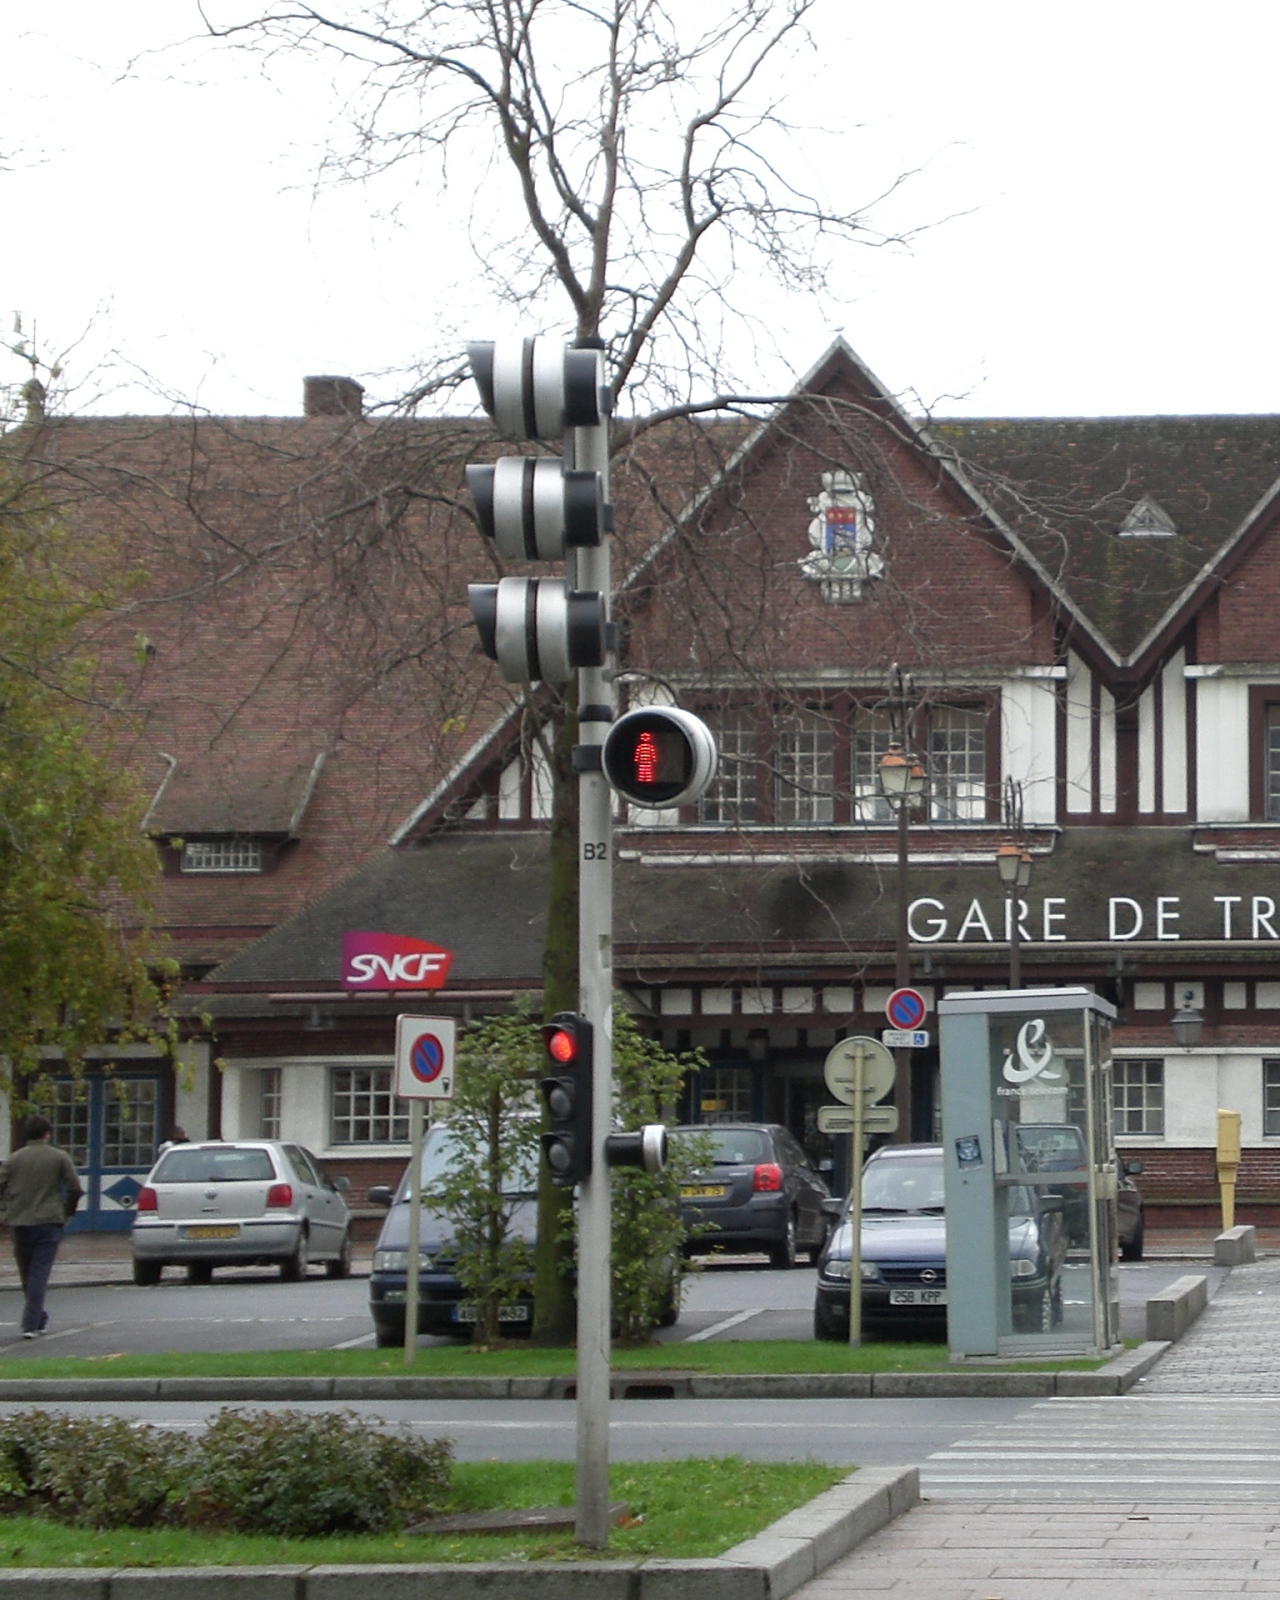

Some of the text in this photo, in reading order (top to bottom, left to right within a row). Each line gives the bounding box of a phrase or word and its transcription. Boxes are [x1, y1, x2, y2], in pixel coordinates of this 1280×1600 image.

[583, 842, 607, 860] B2
[906, 897, 1067, 942] GARE
[1108, 896, 1180, 940] DE
[346, 953, 446, 983] SNCF
[920, 1291, 941, 1303] KPP
